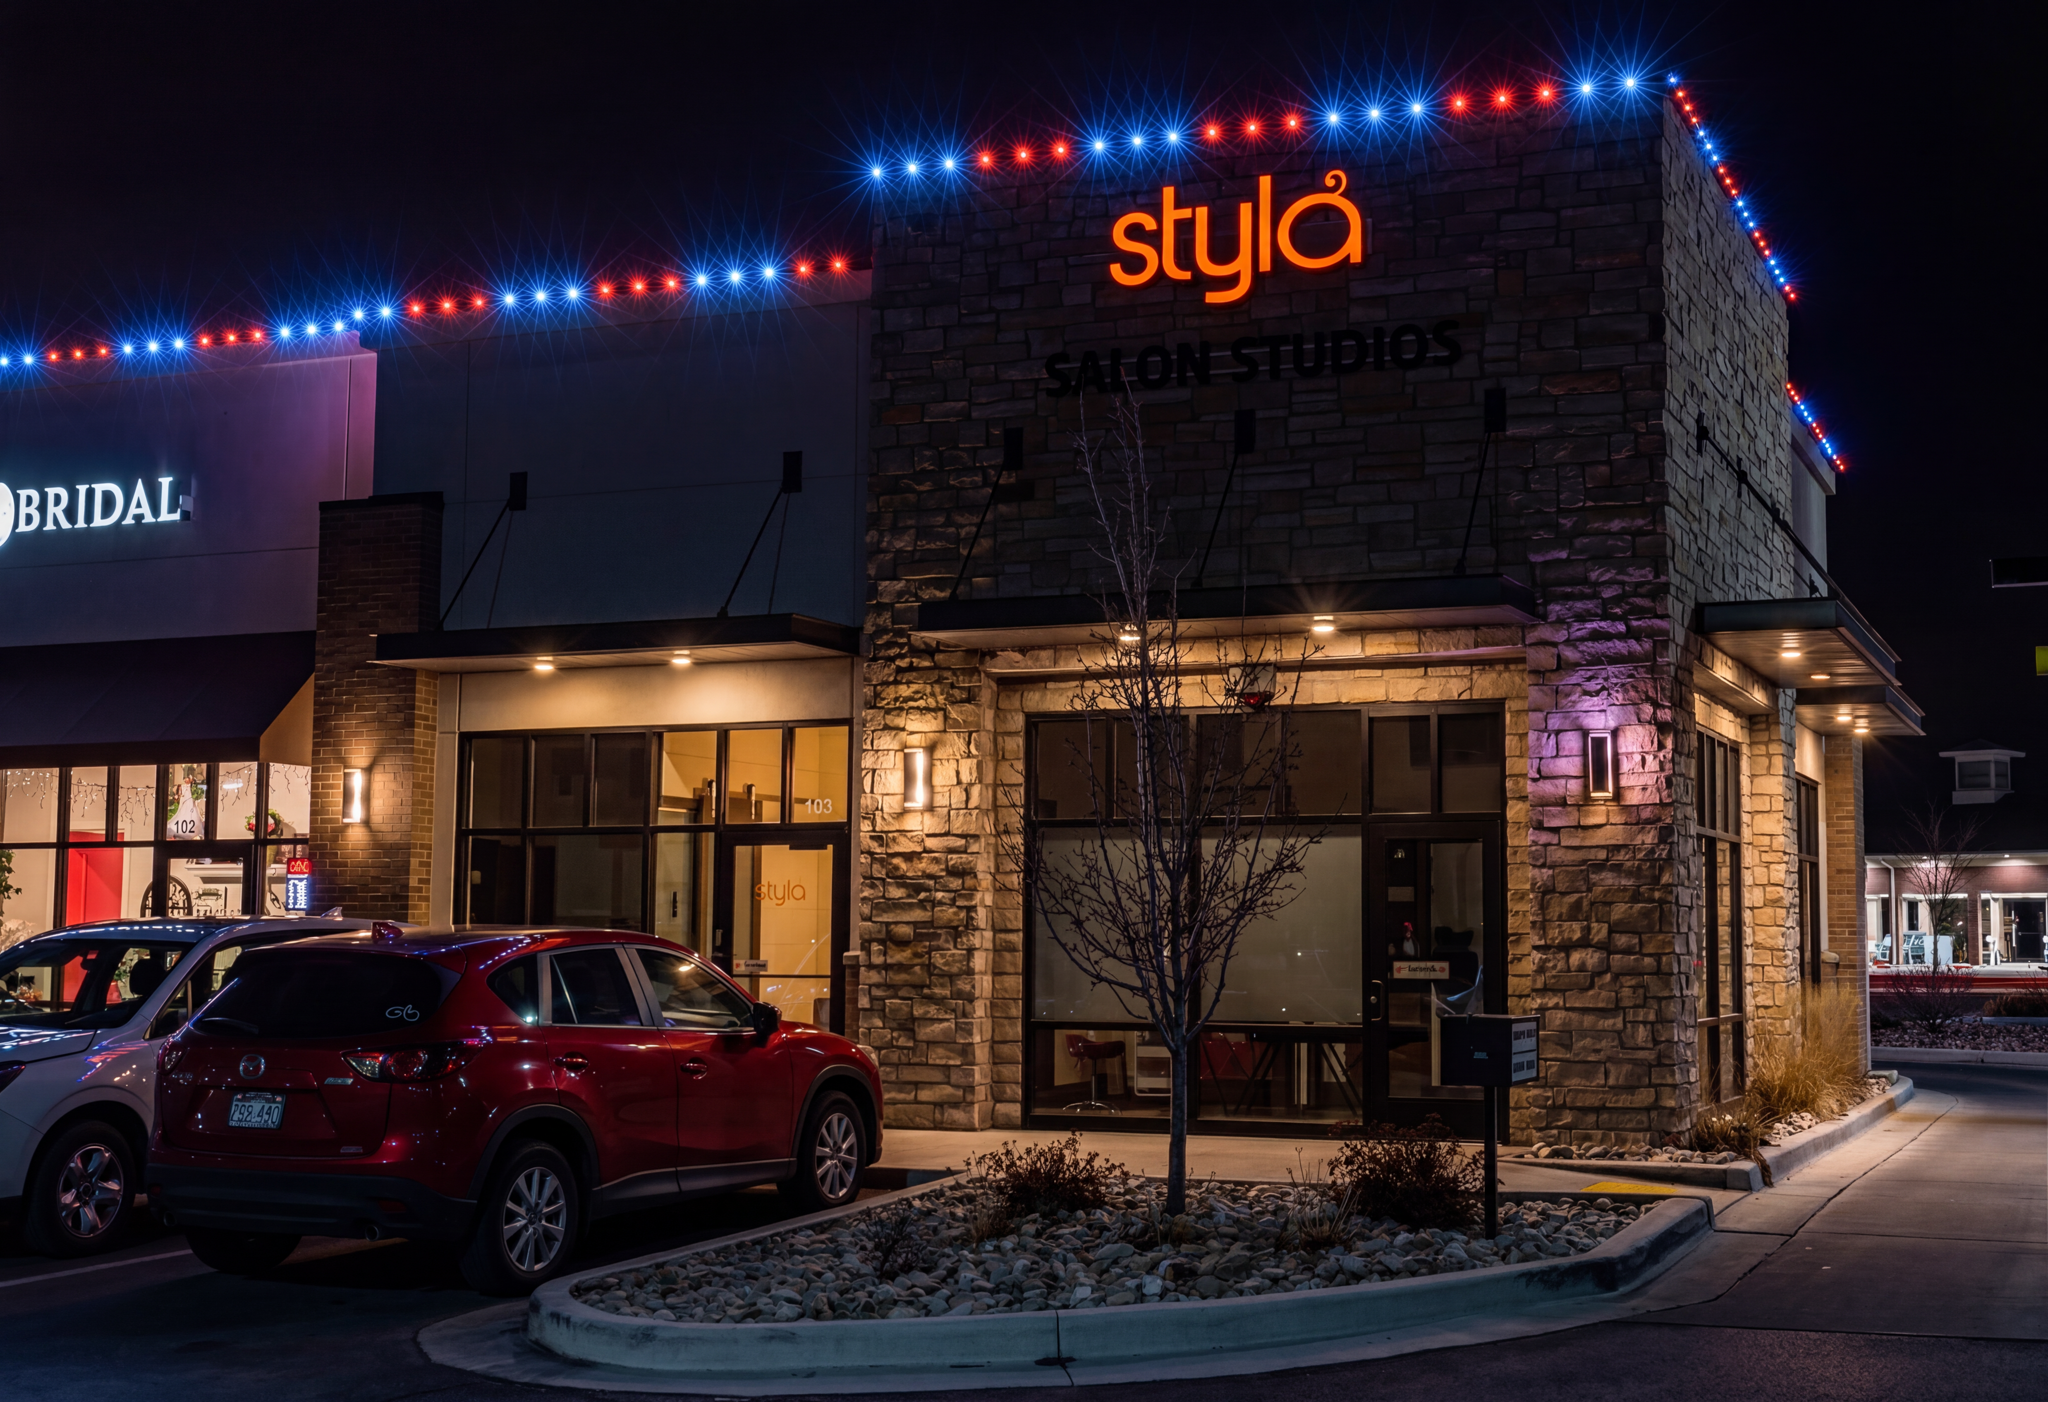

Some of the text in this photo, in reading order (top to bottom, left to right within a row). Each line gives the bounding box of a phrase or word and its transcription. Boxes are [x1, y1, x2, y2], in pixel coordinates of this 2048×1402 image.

[1110, 170, 1362, 303] styla
[1045, 319, 1462, 397] SALON STUDIOS
[15, 477, 181, 532] BRIDAL
[174, 819, 196, 834] 102
[804, 798, 833, 814] 103
[755, 879, 806, 907] styla
